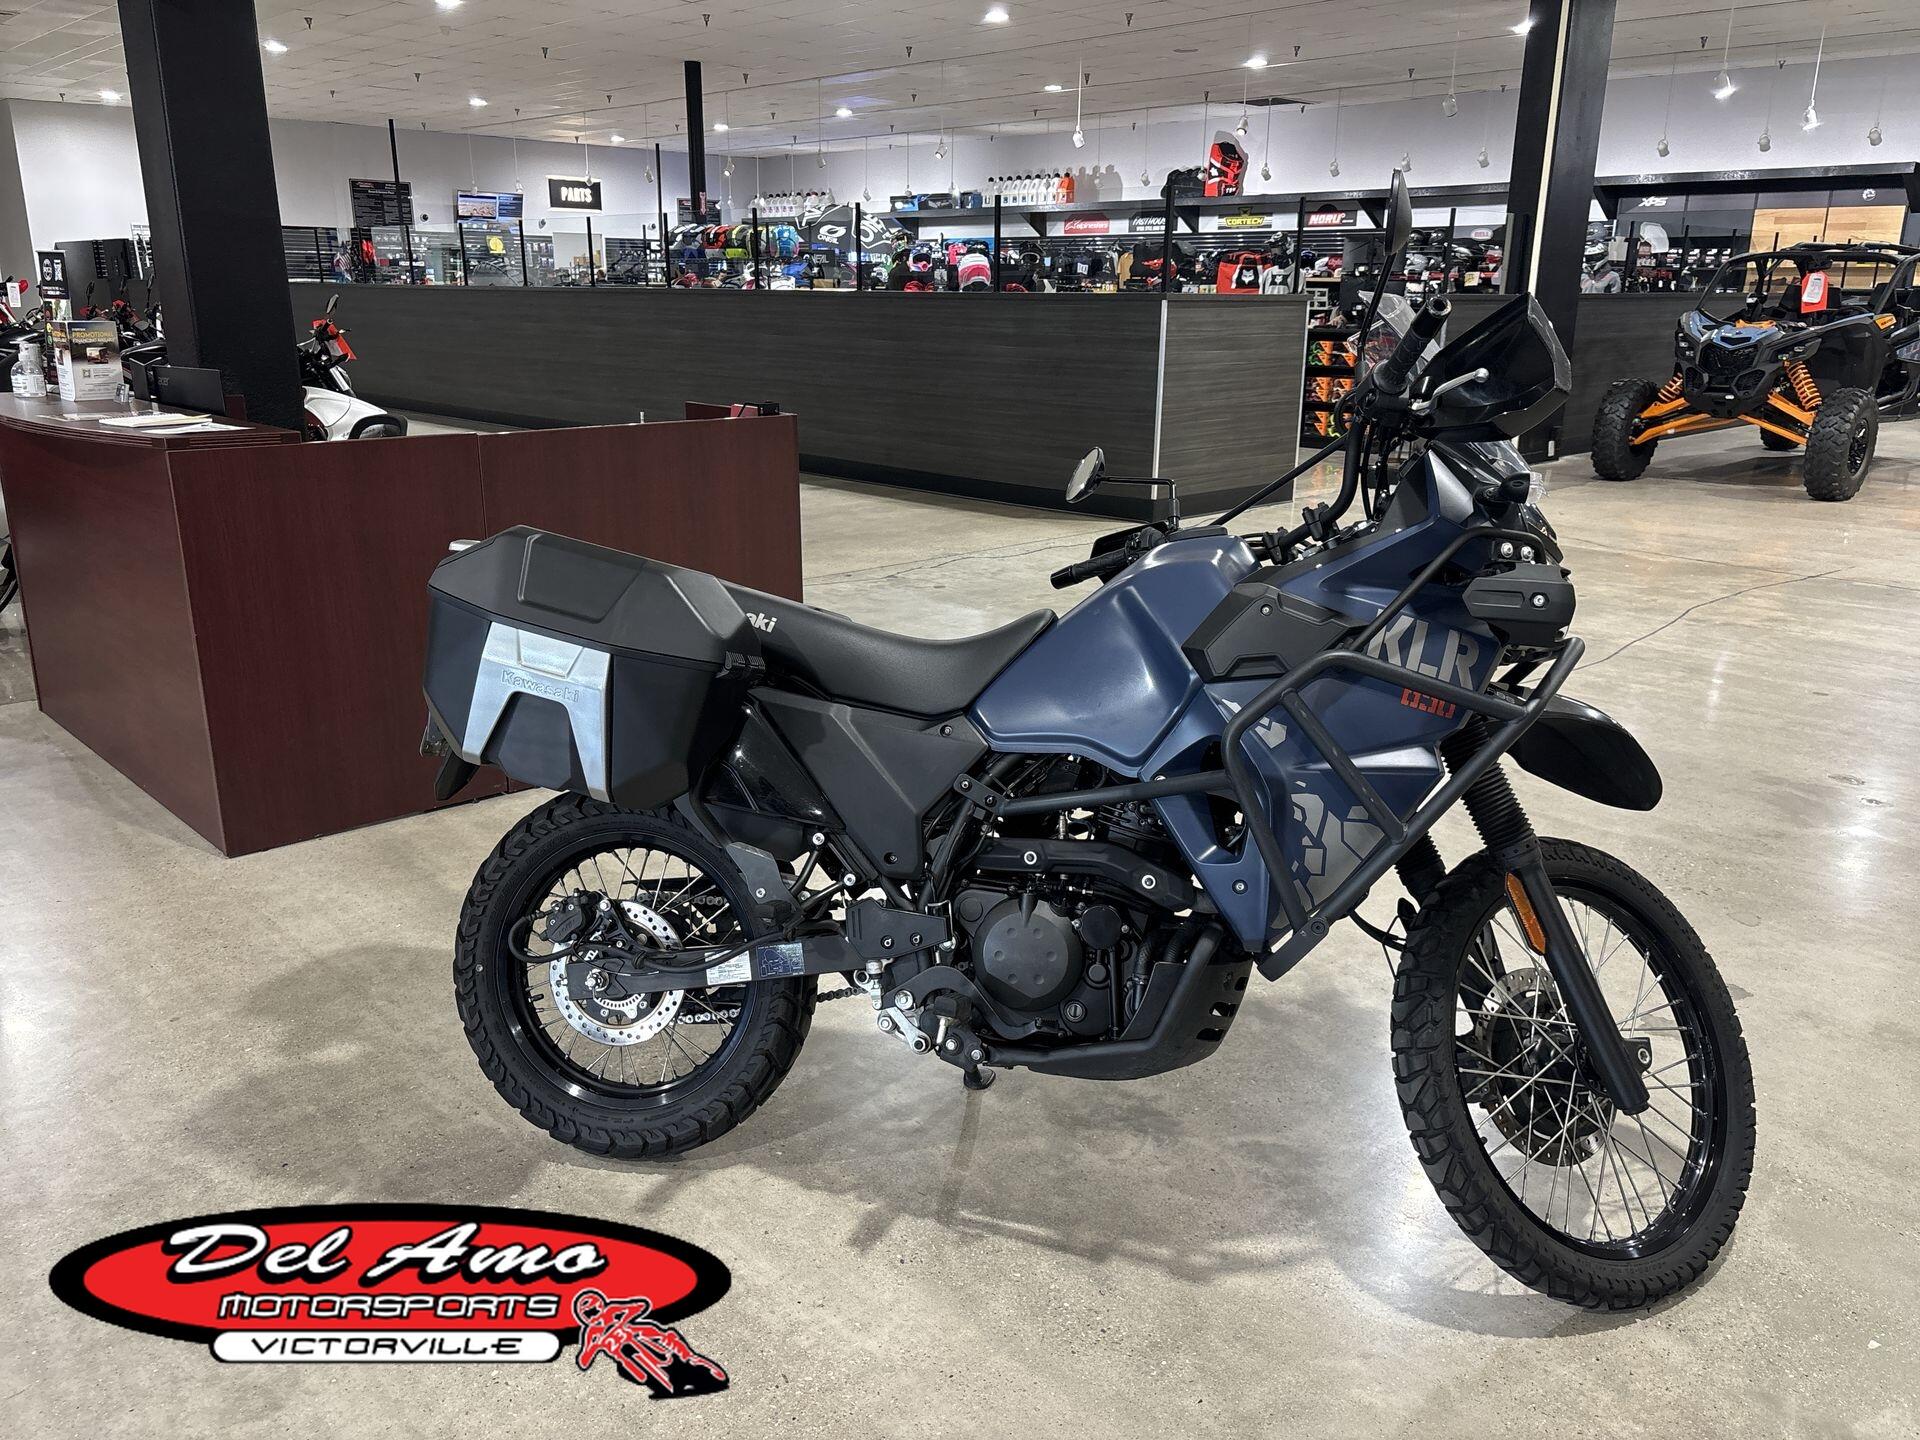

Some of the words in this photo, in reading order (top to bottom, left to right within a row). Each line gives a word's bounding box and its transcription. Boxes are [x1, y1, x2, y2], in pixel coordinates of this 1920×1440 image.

[560, 186, 593, 203] PARTS
[1638, 196, 1669, 207] XPS
[1132, 216, 1167, 226] FASTHOU
[1226, 217, 1263, 226] CORTECH
[1367, 609, 1480, 691] KLR
[501, 669, 580, 702] Kawasaki
